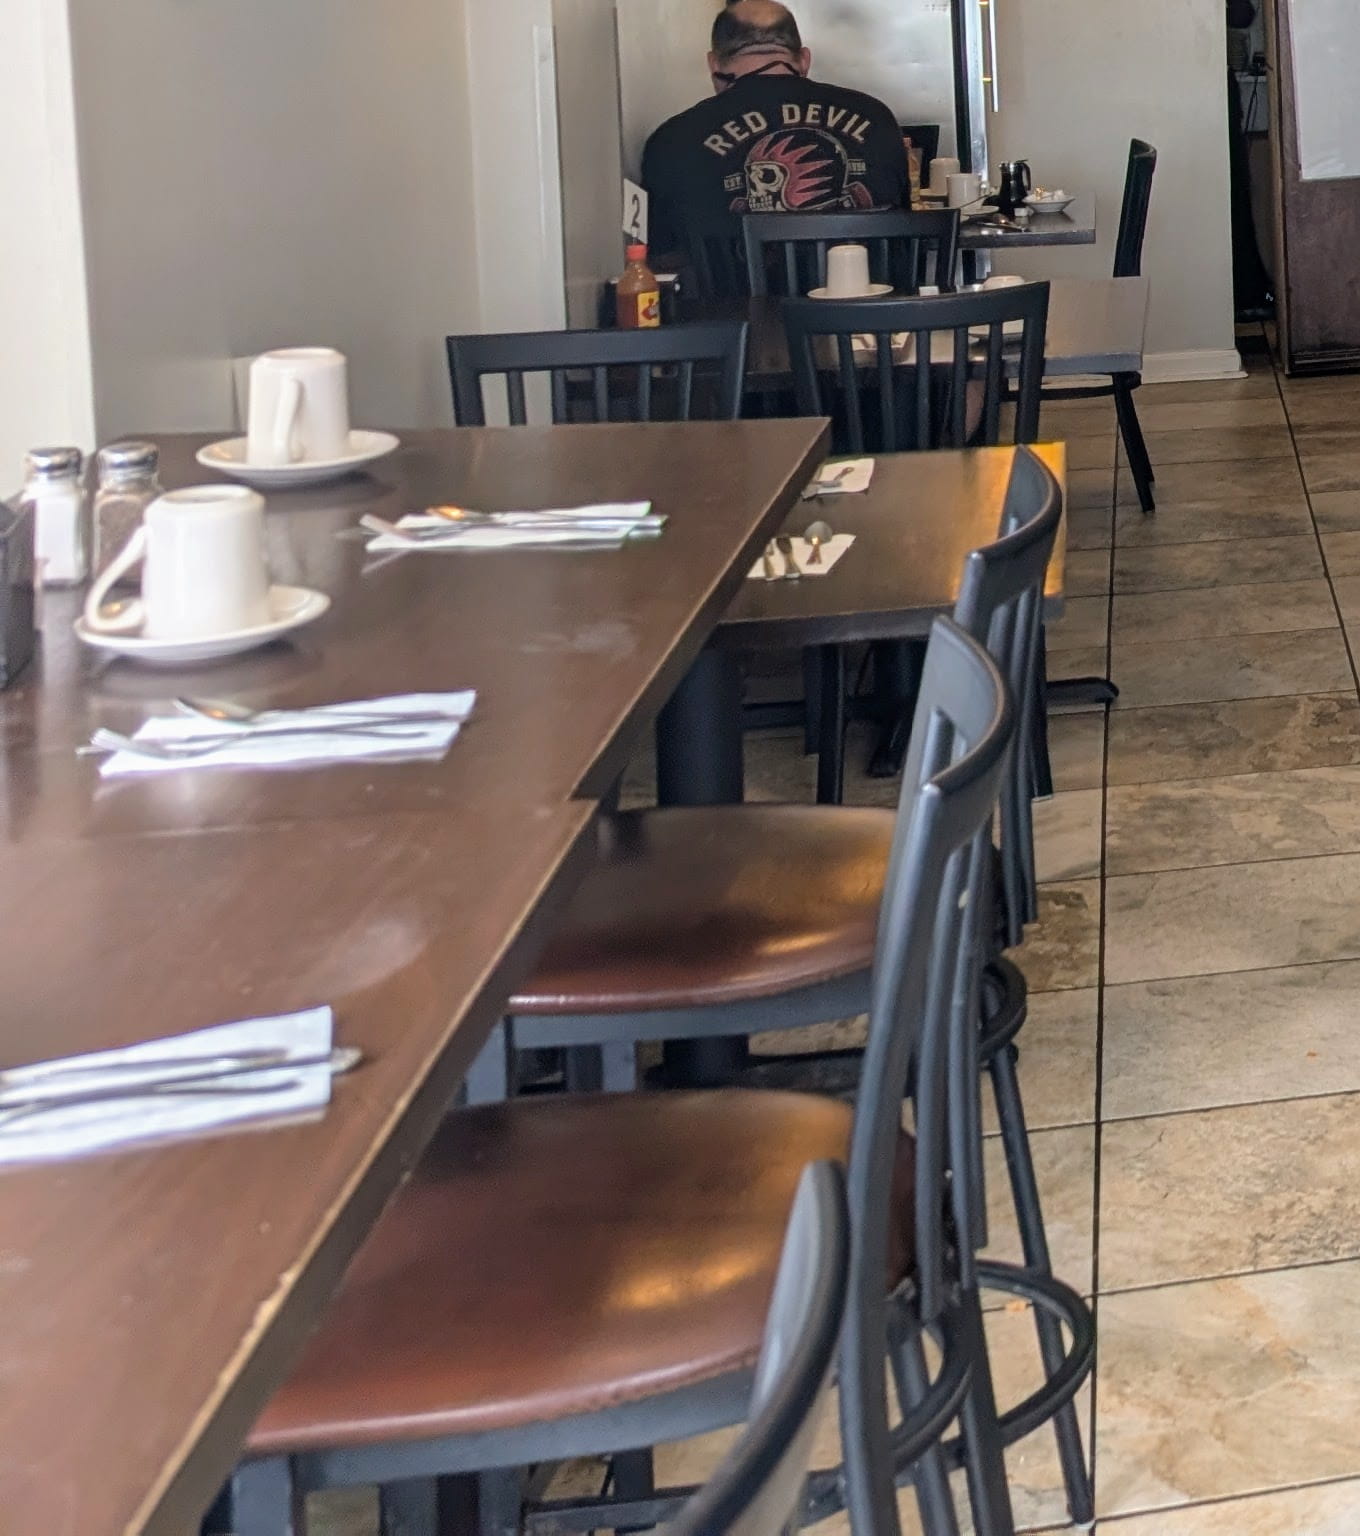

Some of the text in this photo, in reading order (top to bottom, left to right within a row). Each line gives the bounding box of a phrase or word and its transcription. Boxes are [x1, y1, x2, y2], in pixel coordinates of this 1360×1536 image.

[703, 103, 871, 157] RED DEVIL
[631, 193, 641, 229] 2
